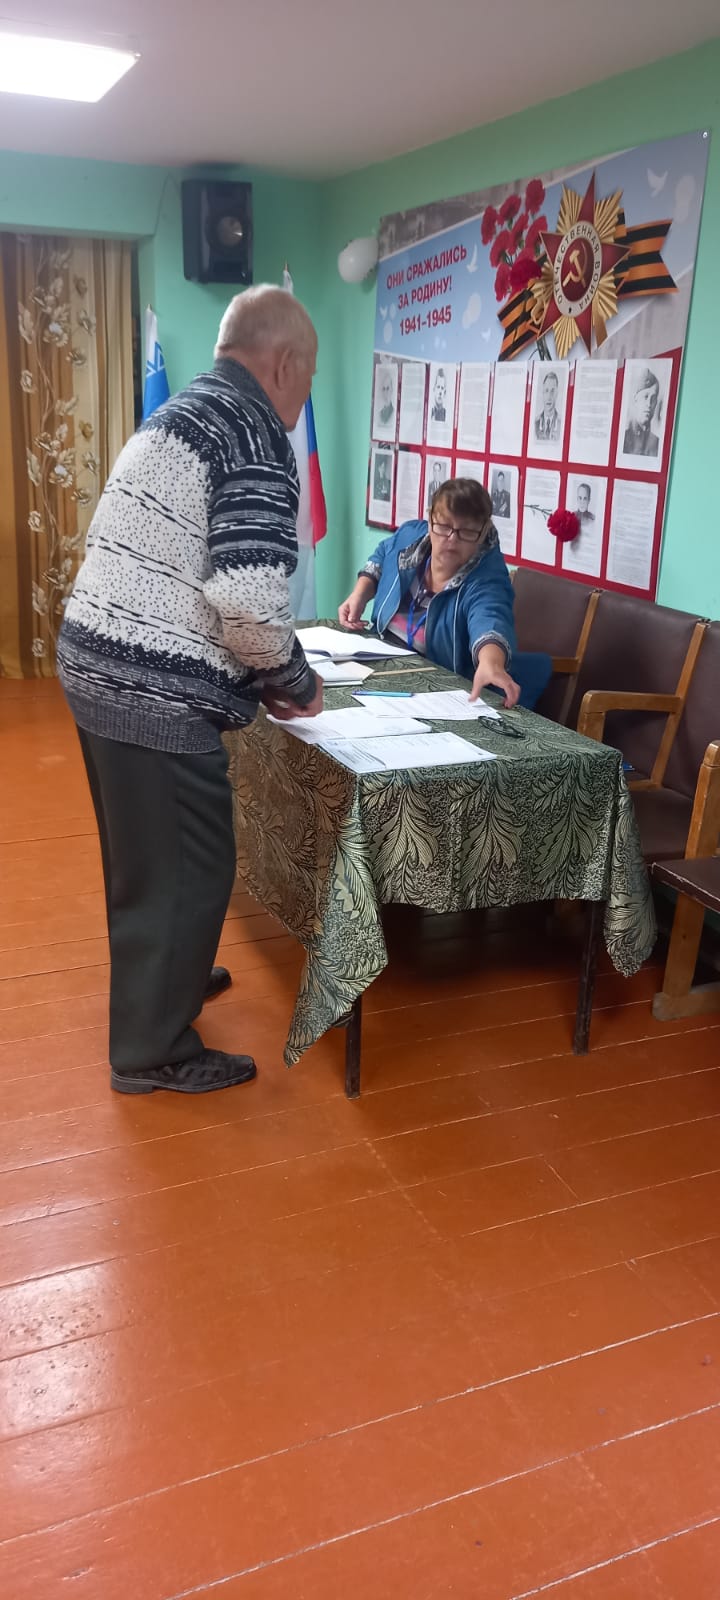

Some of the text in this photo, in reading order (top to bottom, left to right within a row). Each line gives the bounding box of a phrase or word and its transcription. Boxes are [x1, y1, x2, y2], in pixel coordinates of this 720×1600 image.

[386, 244, 467, 290] ОНИ СРАЖАЛИСЬ
[398, 275, 452, 310] ЗА РОДИНУ!
[400, 305, 452, 336] 1941-1945
